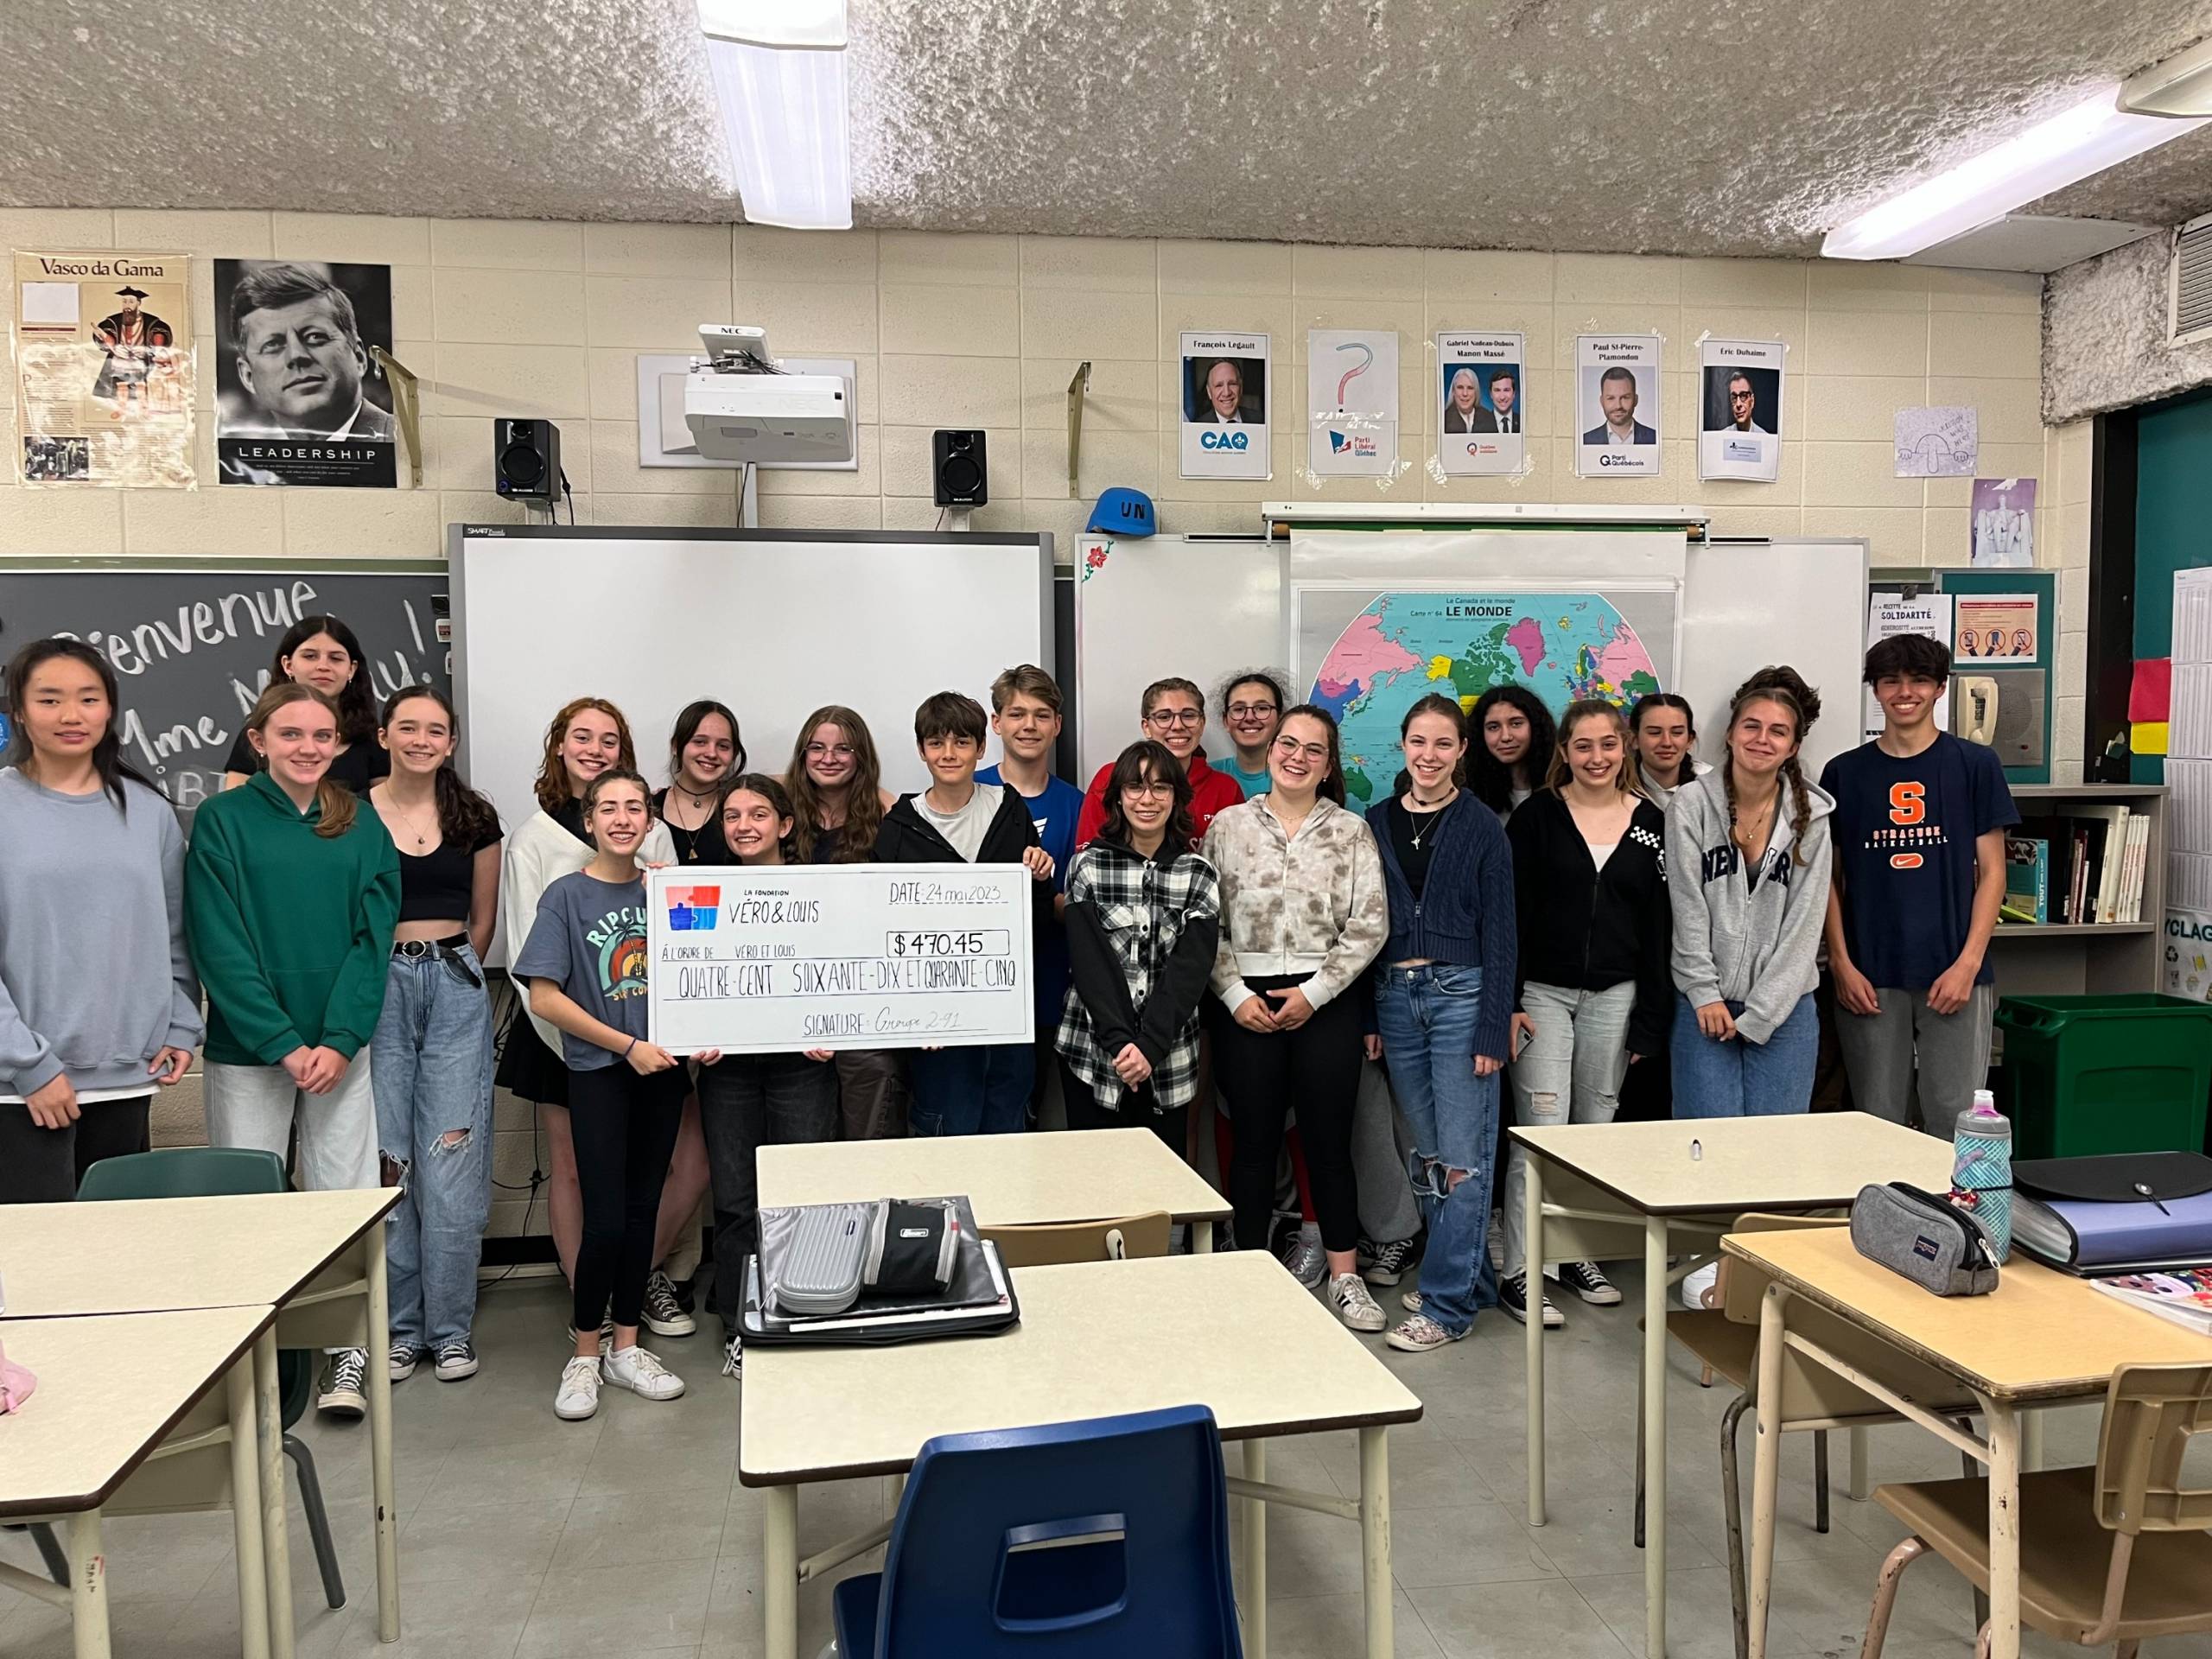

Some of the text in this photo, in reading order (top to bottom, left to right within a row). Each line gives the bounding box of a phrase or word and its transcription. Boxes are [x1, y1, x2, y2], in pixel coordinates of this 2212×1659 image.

[41, 258, 164, 276] Vasco da Gama
[1193, 340, 1226, 349] François
[1200, 431, 1249, 450] CAQ
[238, 447, 376, 461] LEADERSHIP
[1121, 501, 1145, 519] UN
[1446, 607, 1512, 617] LE MONDE
[1881, 607, 1932, 620] SOLIDARITÉ
[1890, 781, 1925, 825] S
[1872, 826, 1941, 840] SYRACUSE
[1865, 836, 1948, 849] BASKETBALL
[926, 883, 942, 900] 24
[945, 890, 968, 901] mai
[969, 885, 1001, 900] 2023
[704, 946, 714, 959] DE
[761, 944, 770, 957] ET
[774, 944, 796, 957] LOUIS
[907, 960, 920, 988] ET
[875, 1007, 920, 1032] Groupe
[925, 1010, 962, 1030] 2-91
